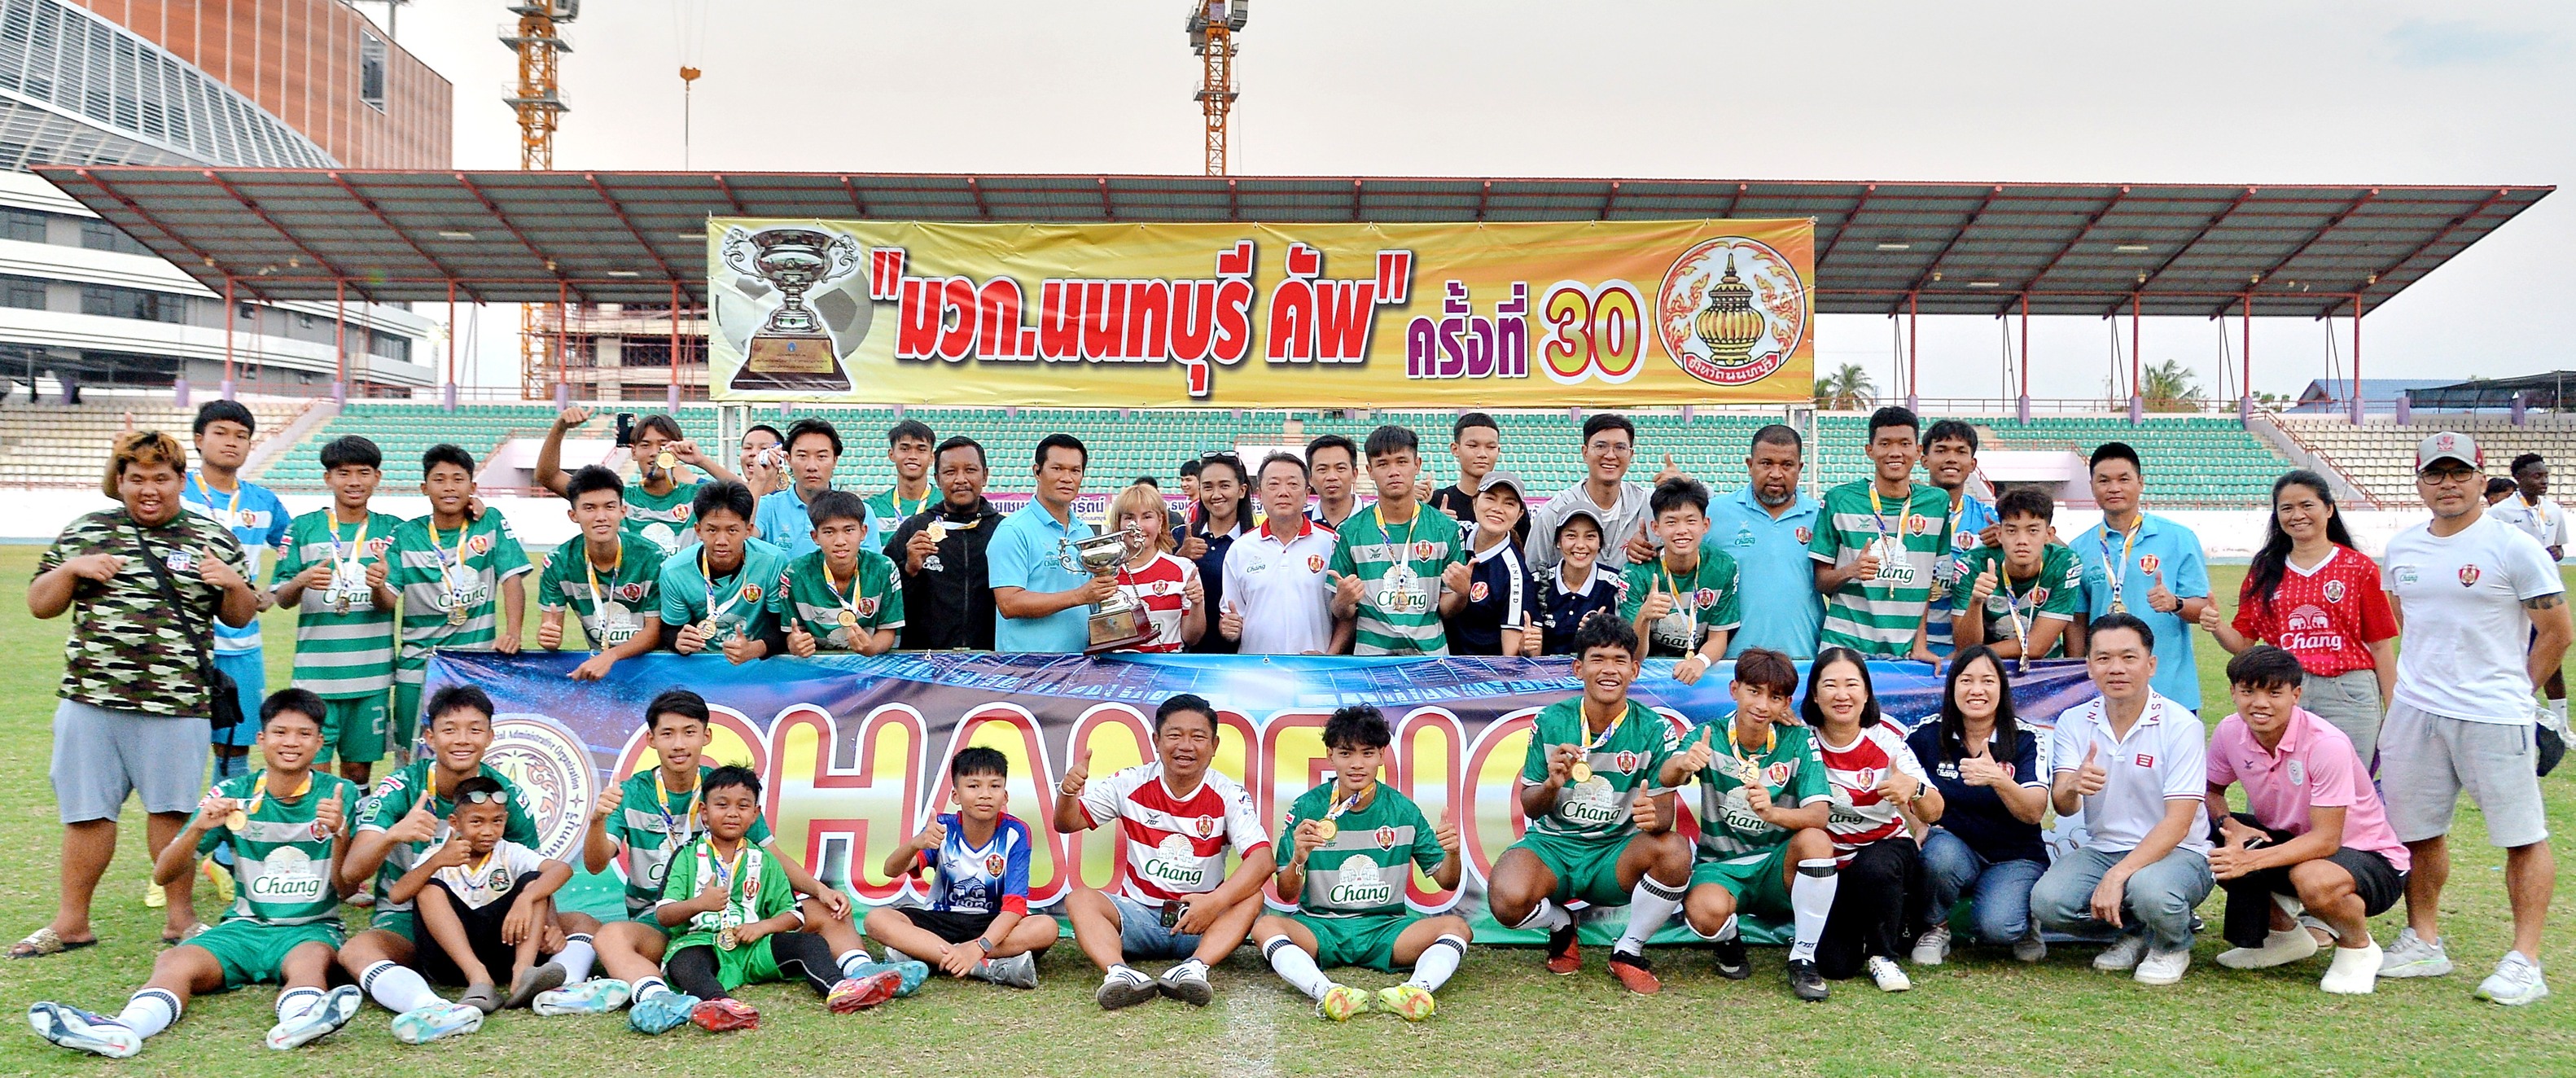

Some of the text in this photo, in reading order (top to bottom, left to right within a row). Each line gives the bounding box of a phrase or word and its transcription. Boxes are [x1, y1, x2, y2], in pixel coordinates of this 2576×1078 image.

[1408, 282, 1643, 380] ครั้งที่ 30
[1246, 564, 1266, 573] Chang
[1509, 563, 1520, 604] UNITED
[2279, 632, 2342, 651] Chang
[554, 745, 580, 791] Organization
[1145, 858, 1203, 884] Chang
[253, 876, 322, 896] Chang
[1330, 884, 1391, 902] Chang
